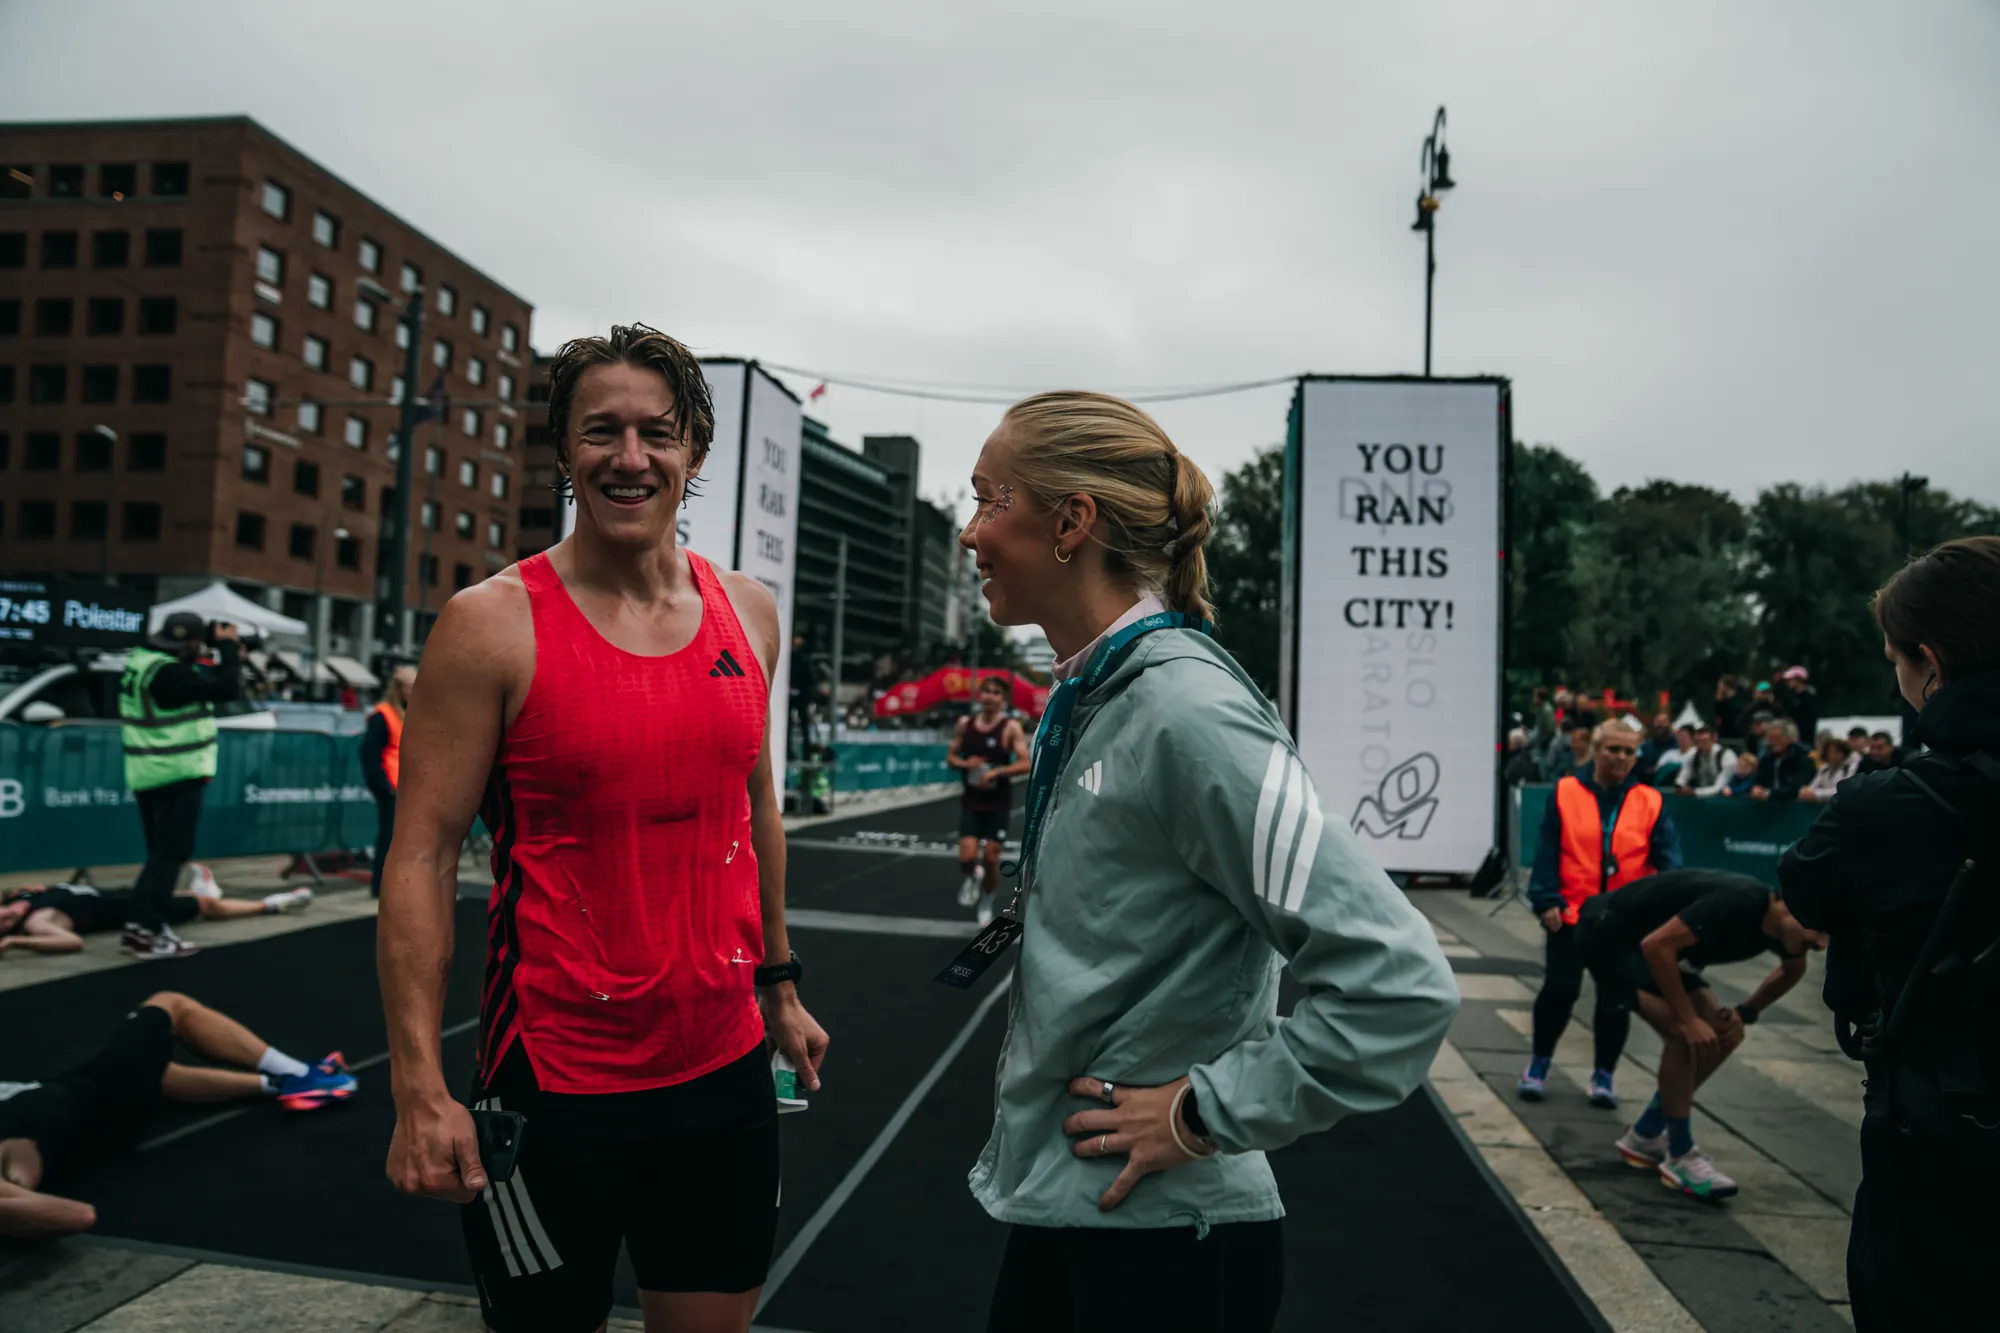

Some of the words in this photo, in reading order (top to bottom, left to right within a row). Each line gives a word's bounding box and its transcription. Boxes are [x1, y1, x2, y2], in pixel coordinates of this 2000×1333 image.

[1357, 443, 1444, 475] YOU
[1355, 494, 1446, 525] RAN
[1351, 546, 1449, 579] THIS
[64, 600, 144, 632] Polestar
[1344, 597, 1455, 630] CITY!
[1094, 644, 1115, 676] Sammen
[1050, 725, 1062, 746] DNB
